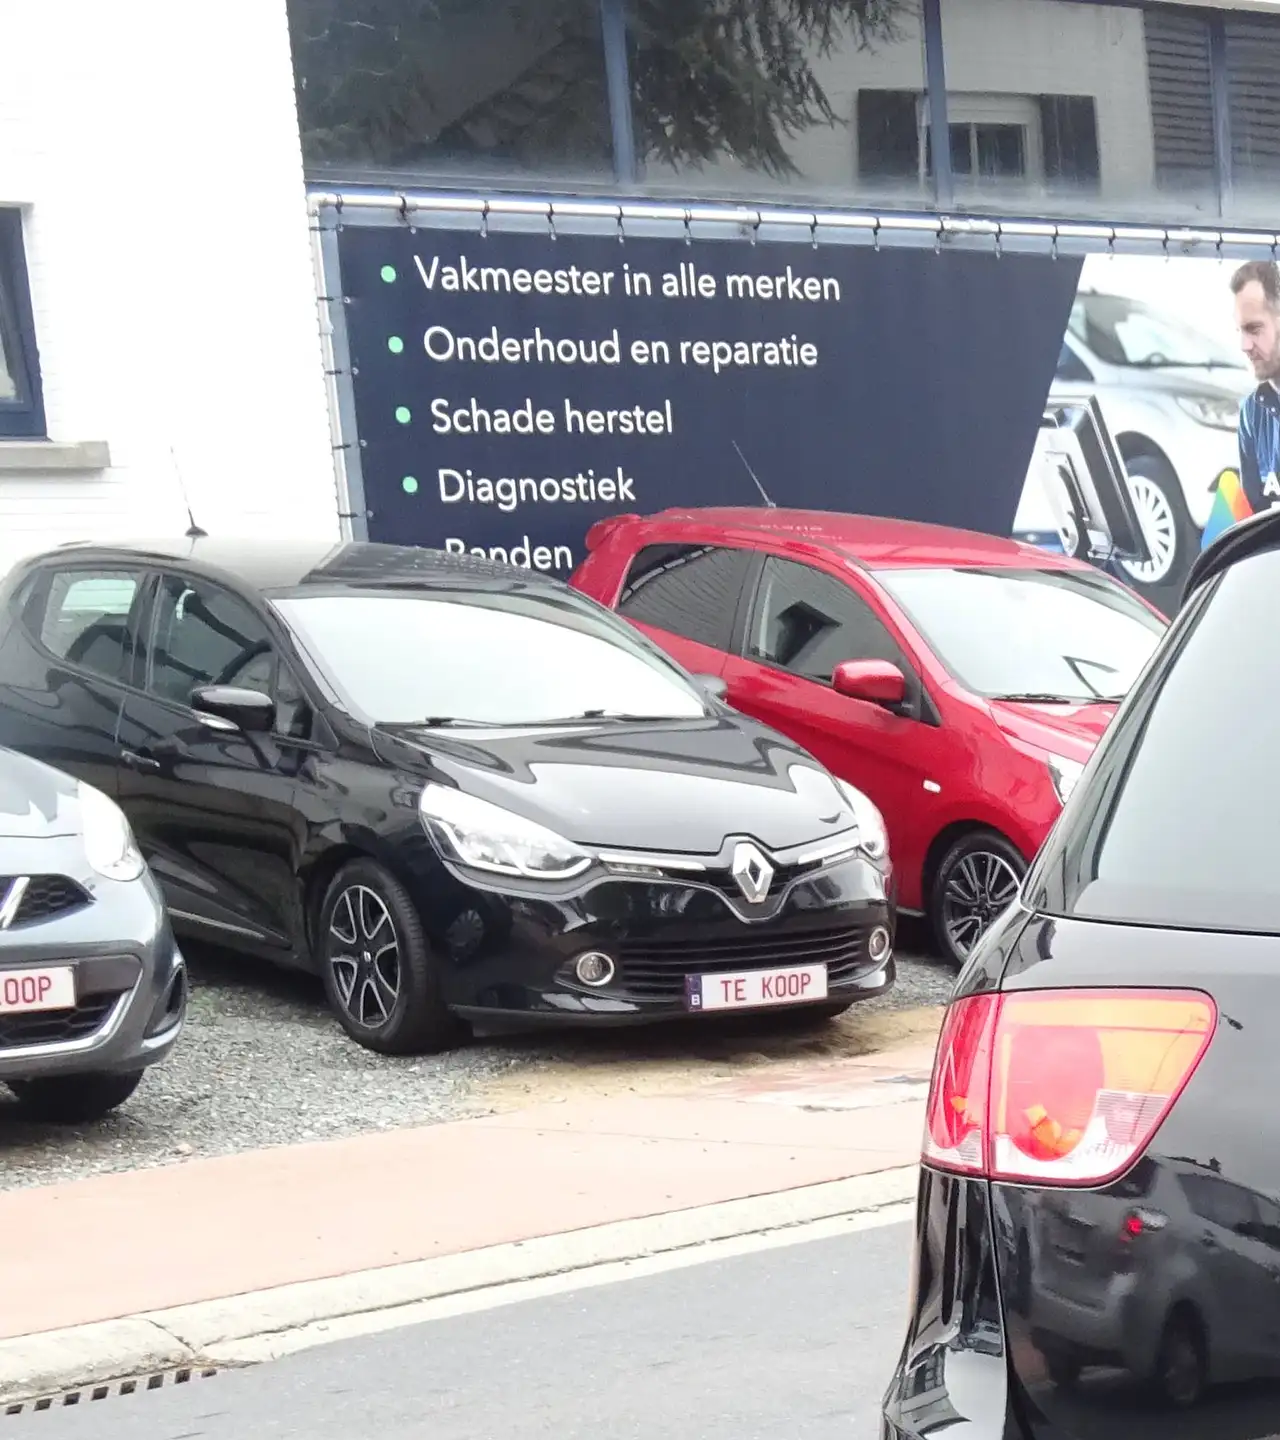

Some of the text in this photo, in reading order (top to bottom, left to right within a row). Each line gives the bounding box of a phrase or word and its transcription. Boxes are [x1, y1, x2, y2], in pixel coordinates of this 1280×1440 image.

[414, 255, 841, 301] Vakmeester in alle merken
[423, 326, 819, 374] Onderhoud en reparatie
[431, 399, 674, 434] Schade herstel
[438, 468, 636, 511] Diagnostiek
[0, 976, 51, 1005] OOP
[720, 973, 811, 1002] TE KOOP
